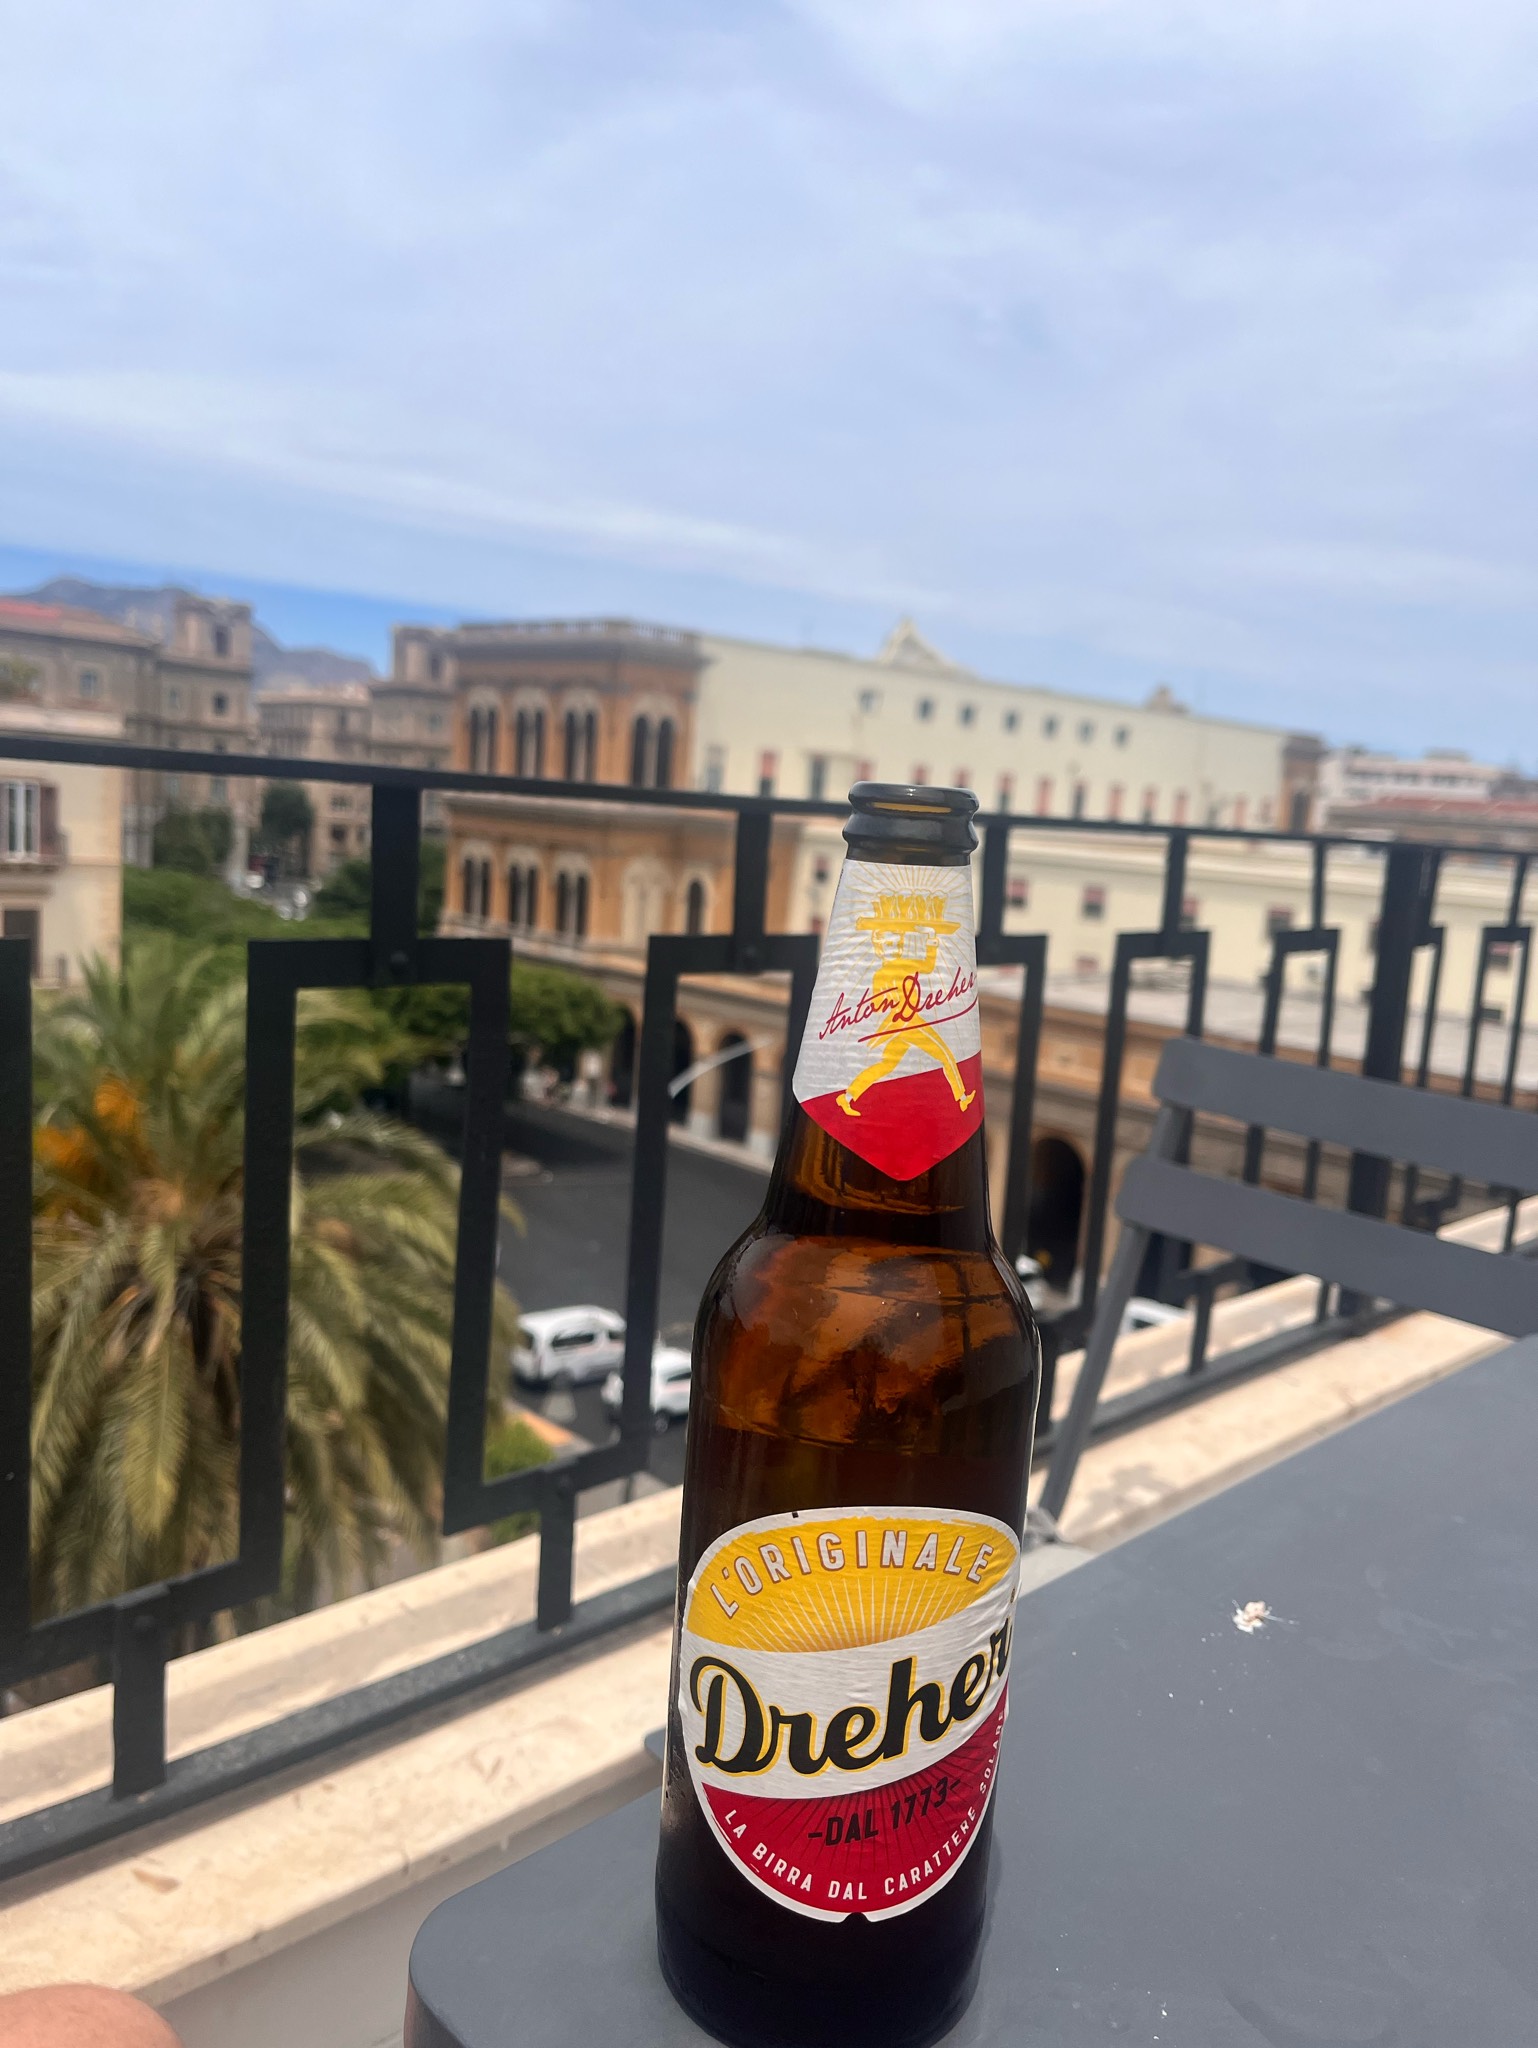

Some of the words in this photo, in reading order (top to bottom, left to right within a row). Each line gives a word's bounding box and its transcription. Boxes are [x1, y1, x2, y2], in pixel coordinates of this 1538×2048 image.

[819, 986, 899, 1040] Anton
[710, 1529, 994, 1619] L'ORIGINALE
[689, 1617, 1013, 1777] Dreher
[725, 1809, 748, 1839] LA
[752, 1842, 813, 1893] BIRRA
[827, 1880, 868, 1901] DAL
[884, 1806, 977, 1896] CARATTERE
